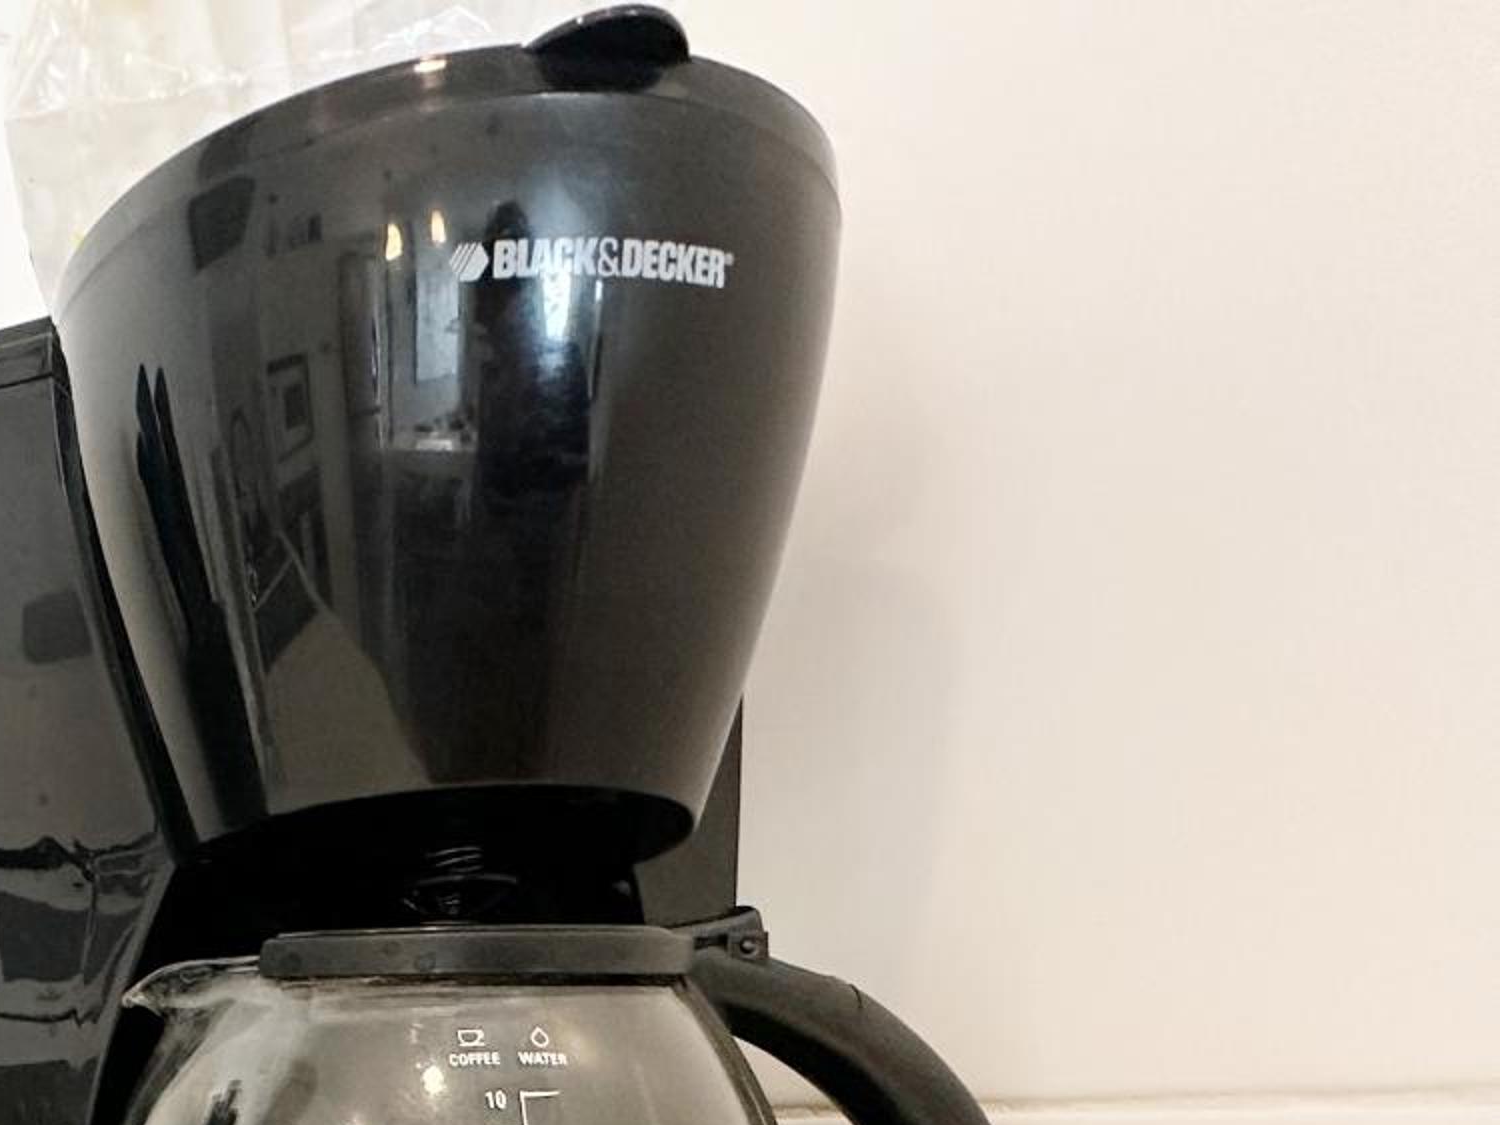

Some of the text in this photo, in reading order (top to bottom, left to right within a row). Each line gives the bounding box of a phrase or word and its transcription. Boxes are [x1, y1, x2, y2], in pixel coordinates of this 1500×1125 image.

[449, 1051, 568, 1067] COFFEE WATER
[485, 1090, 507, 1110] 10
